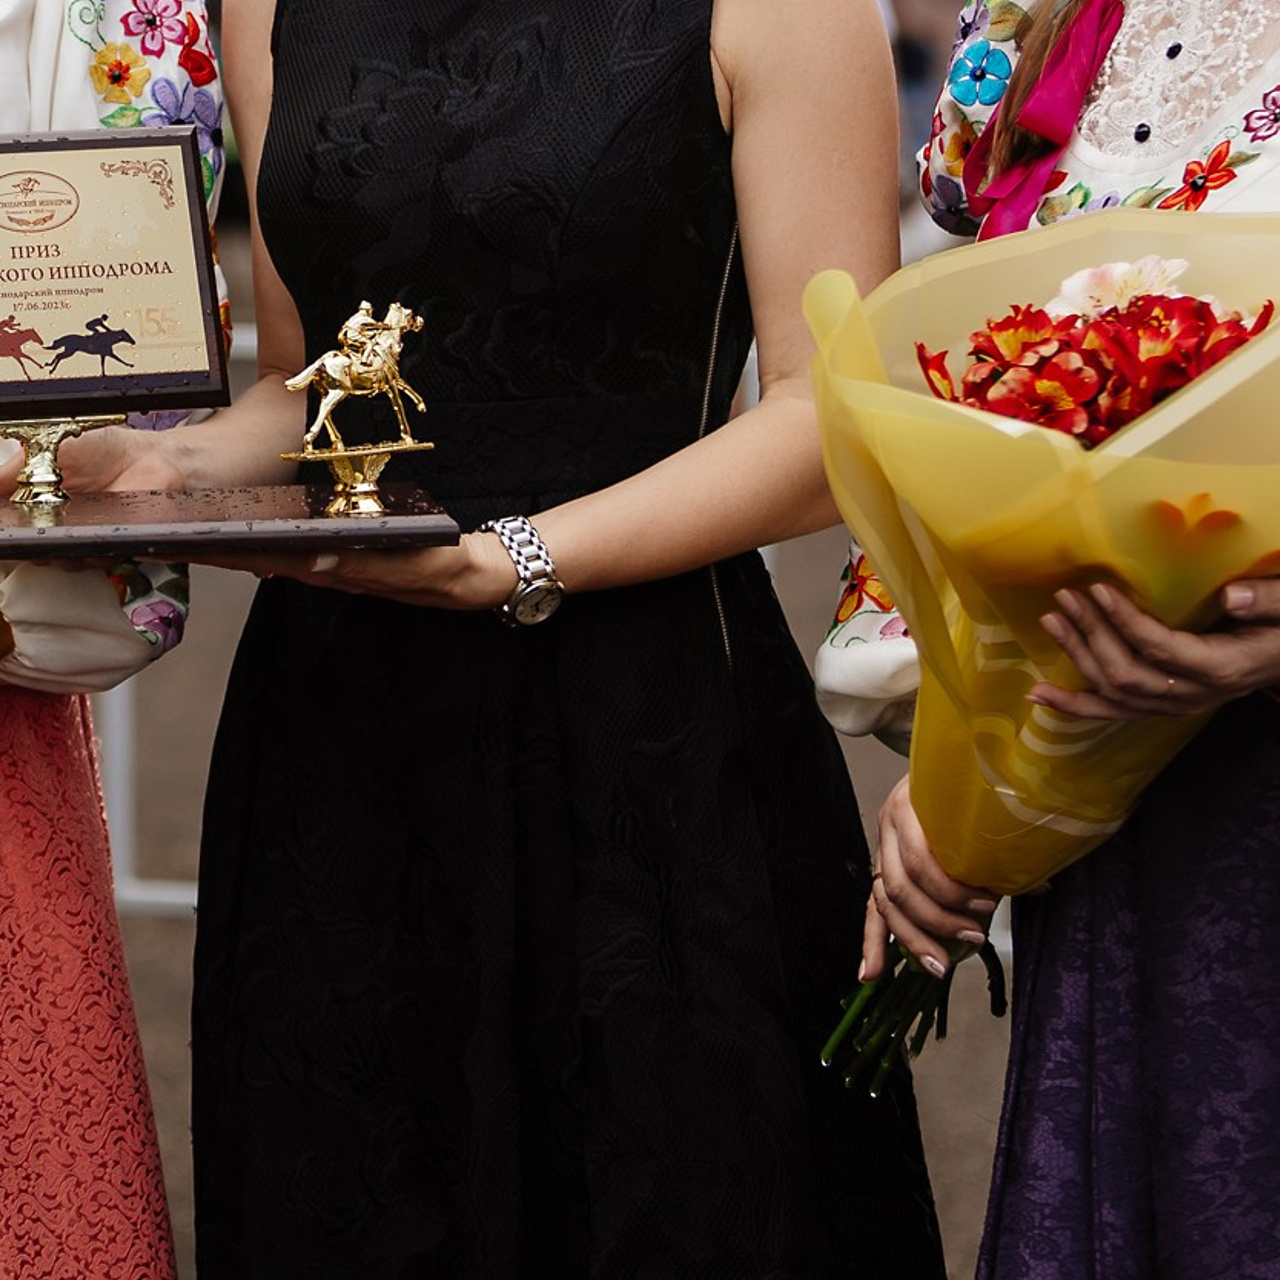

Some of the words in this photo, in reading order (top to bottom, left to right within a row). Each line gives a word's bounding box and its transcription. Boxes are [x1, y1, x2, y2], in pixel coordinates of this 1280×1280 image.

[10, 244, 61, 260] ПРИЗ
[49, 261, 173, 280] ИППОДРОМА
[55, 287, 104, 297] ипподром
